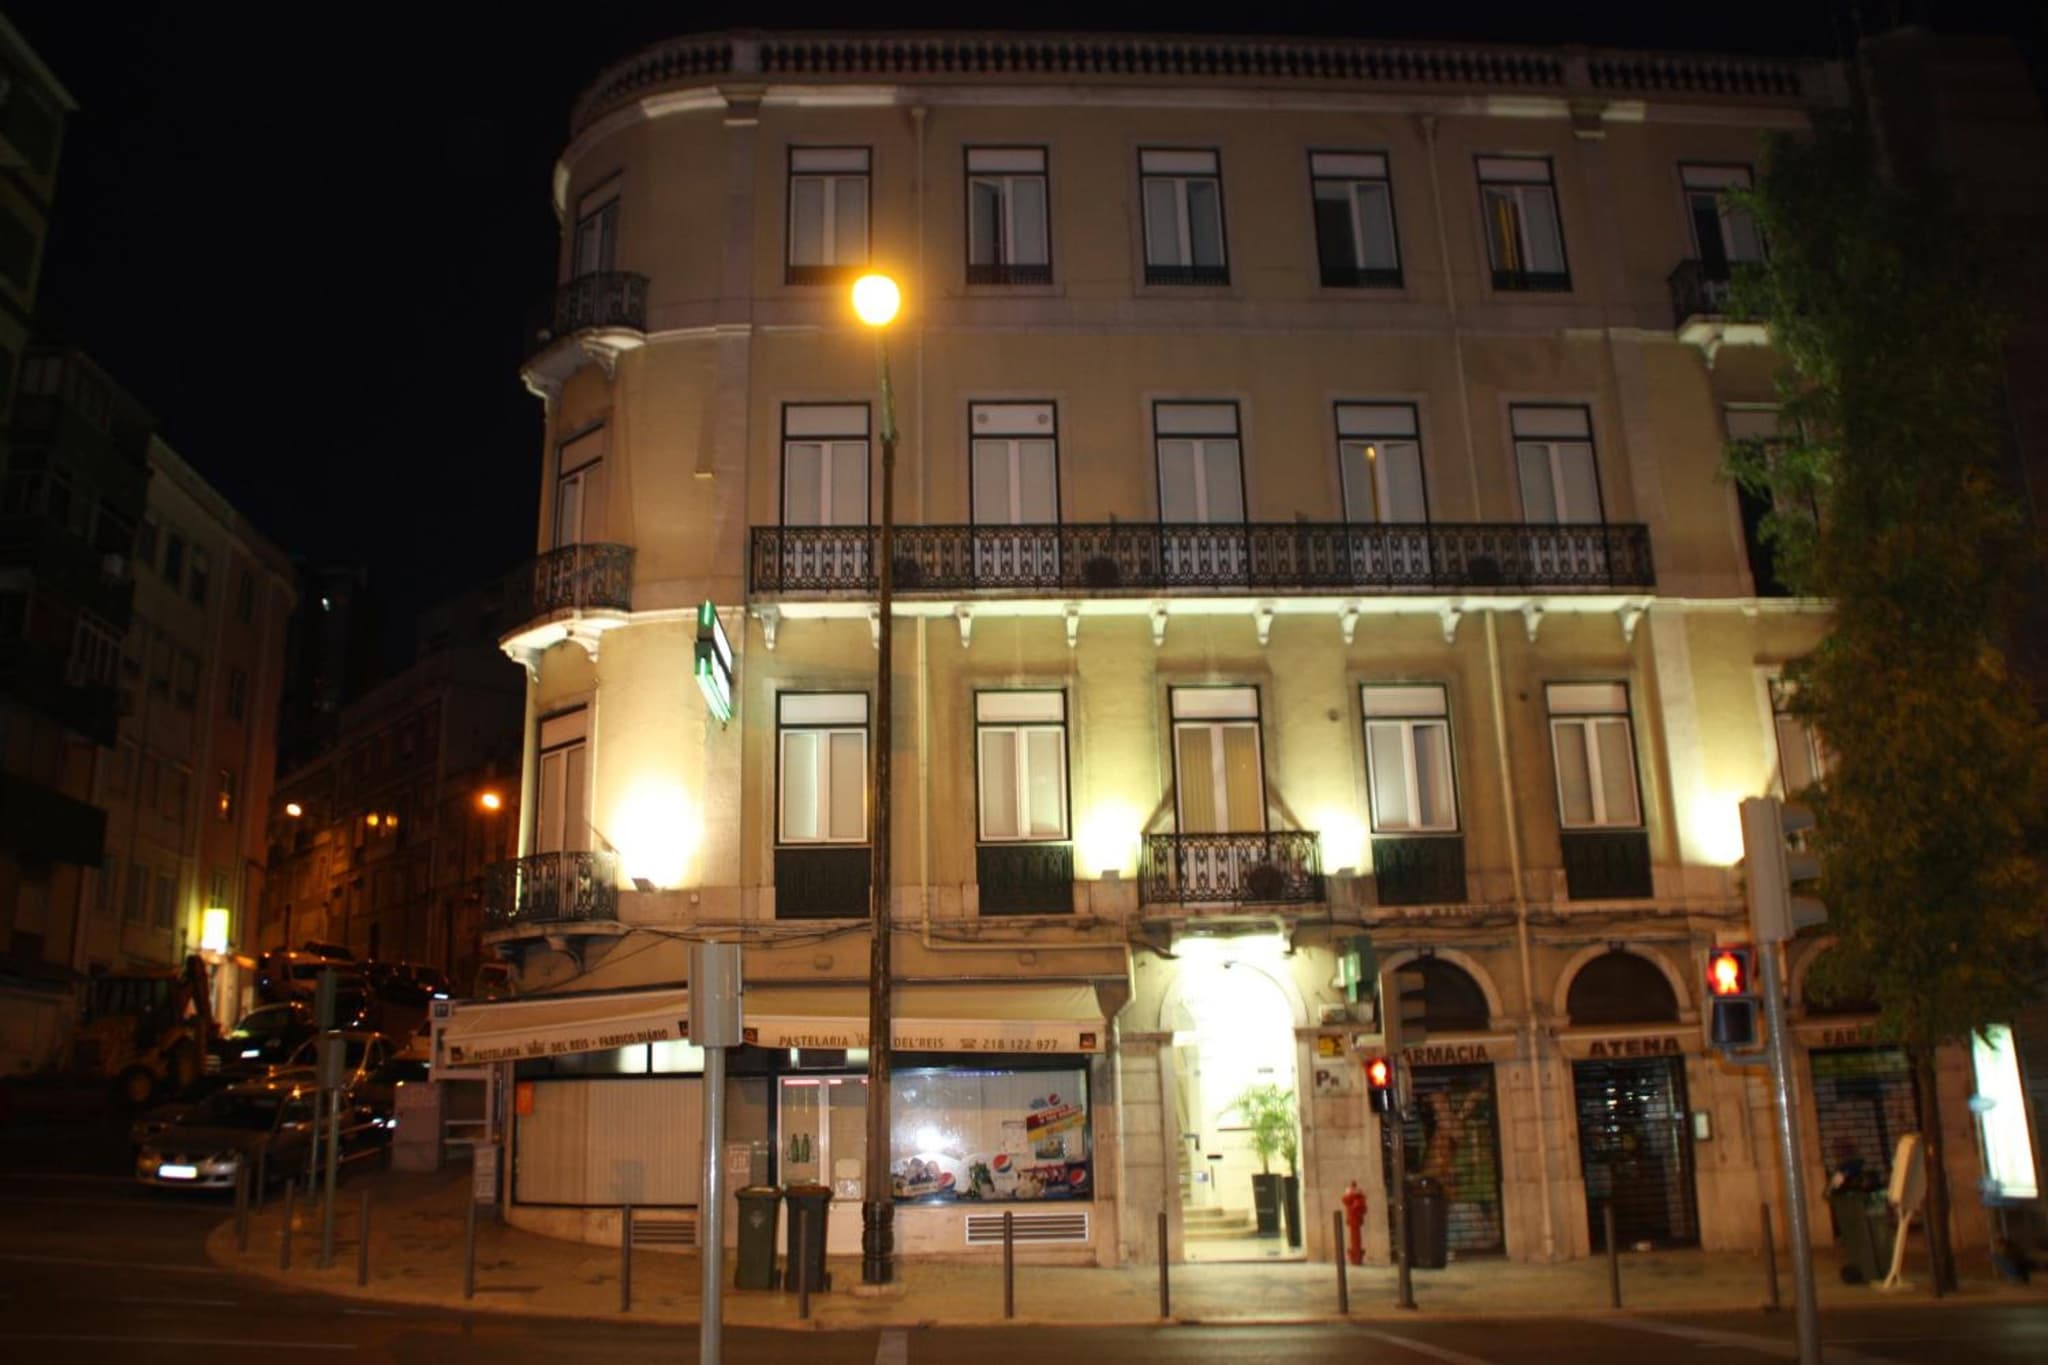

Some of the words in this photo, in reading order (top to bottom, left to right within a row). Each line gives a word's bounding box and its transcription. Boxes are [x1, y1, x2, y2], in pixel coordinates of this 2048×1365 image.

[778, 1035, 848, 1047] PASTELARIA
[982, 1038, 1005, 1050] 218
[1011, 1038, 1032, 1050] 122
[1036, 1038, 1058, 1051] 977
[1588, 1037, 1680, 1056] ATENA
[1401, 1044, 1489, 1064] ARMACIA
